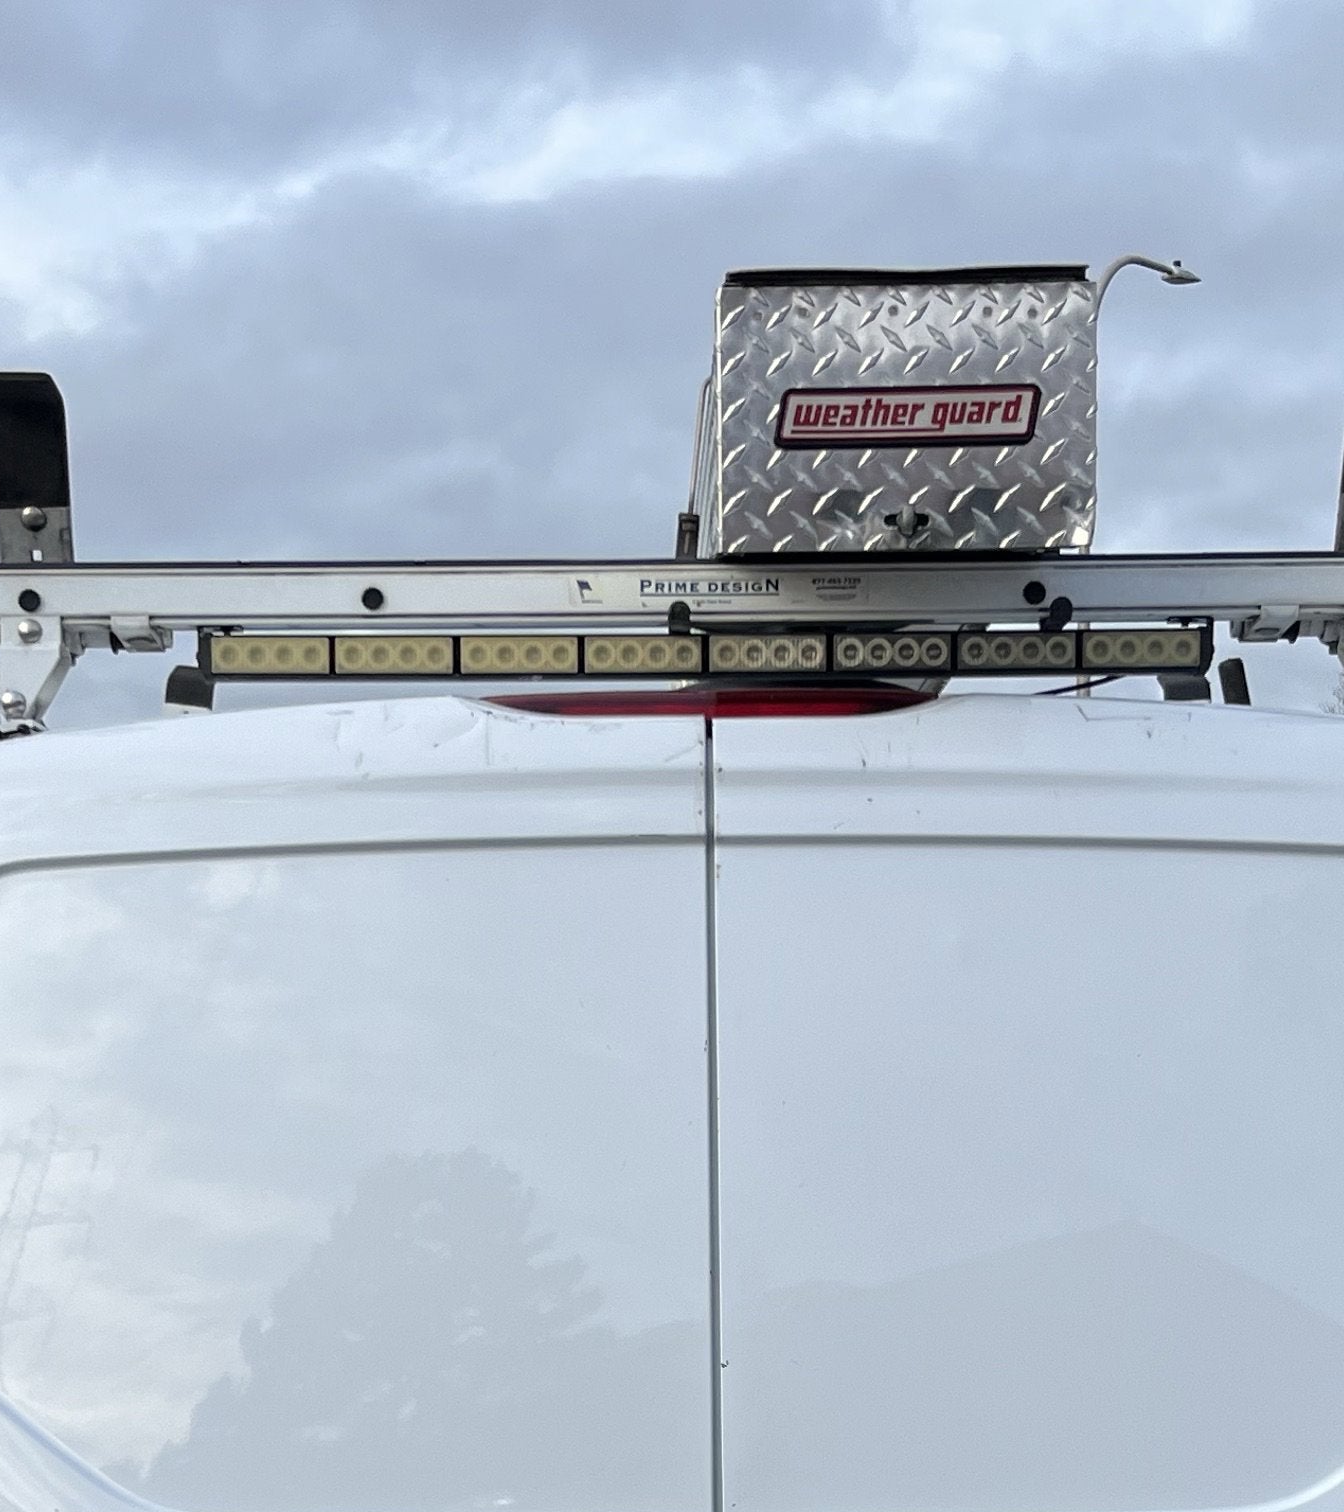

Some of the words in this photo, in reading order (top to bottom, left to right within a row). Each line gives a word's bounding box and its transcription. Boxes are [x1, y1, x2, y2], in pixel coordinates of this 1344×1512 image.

[792, 398, 930, 427] weather
[931, 394, 1020, 432] guard
[640, 579, 699, 593] PRIME
